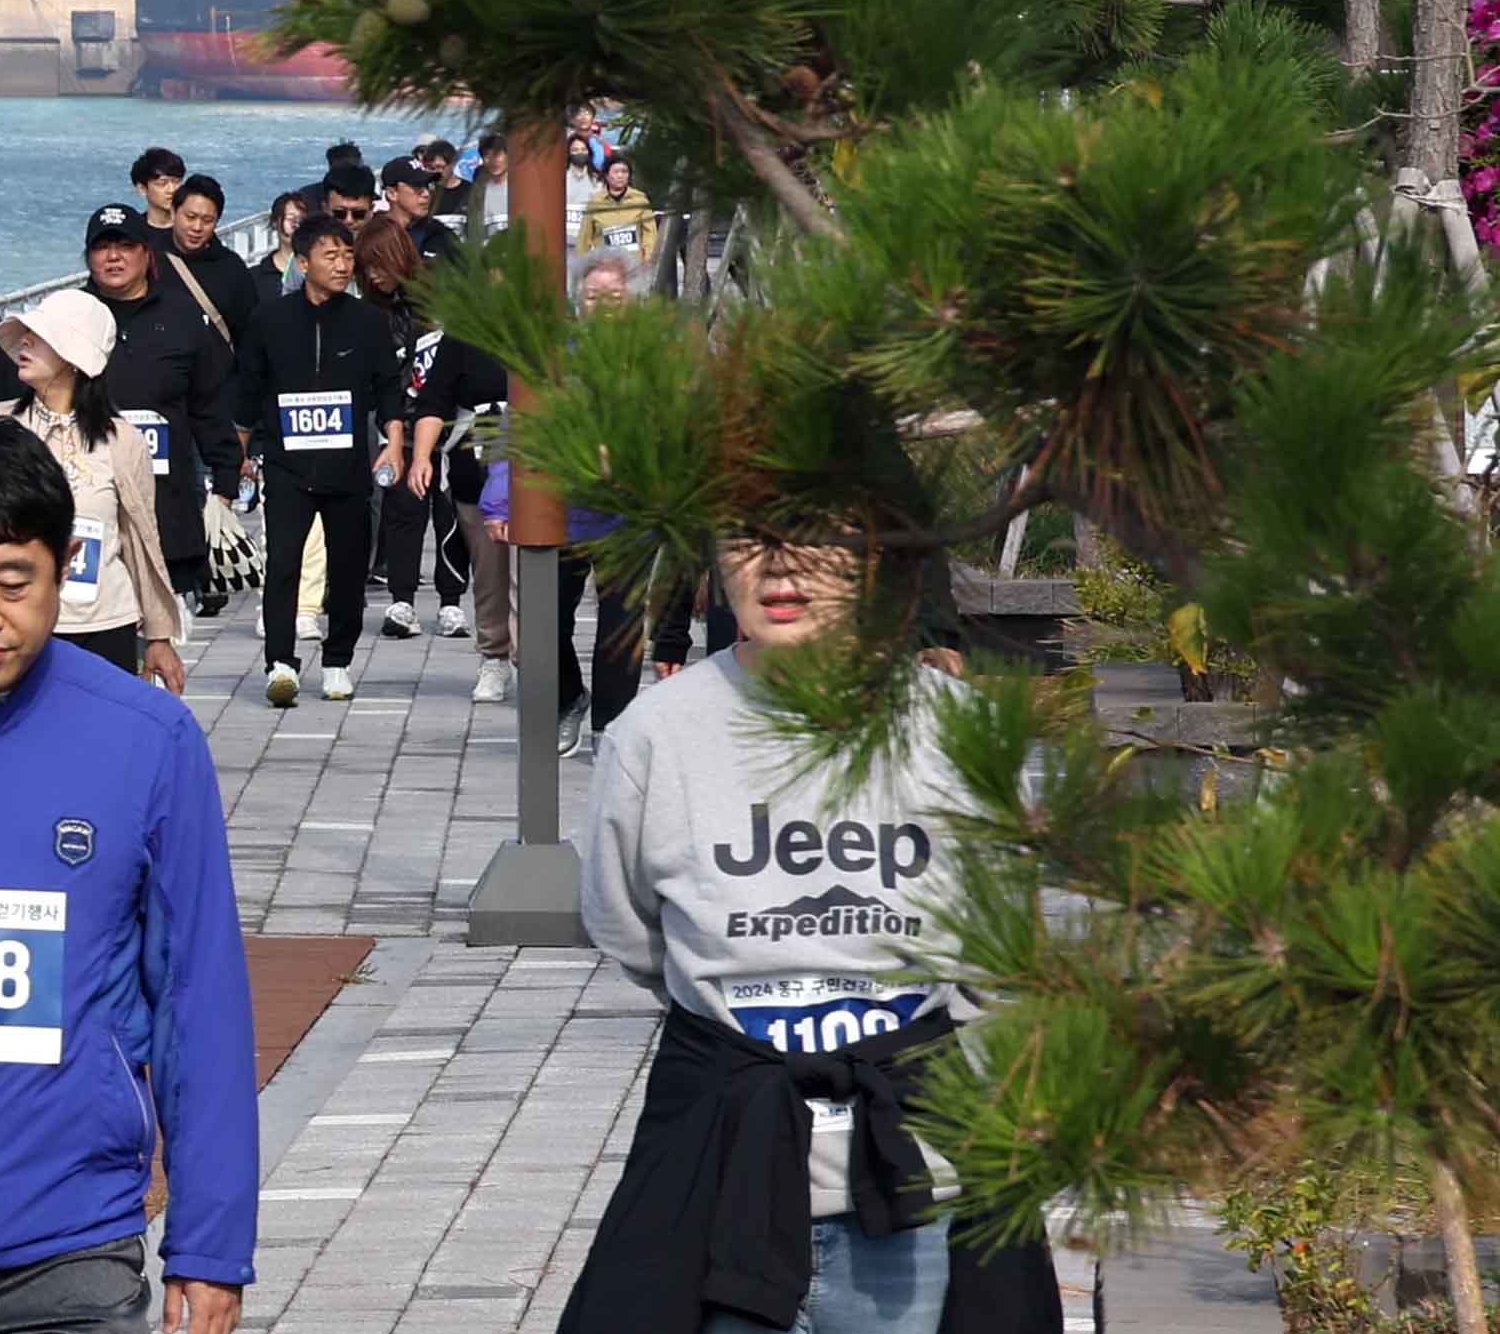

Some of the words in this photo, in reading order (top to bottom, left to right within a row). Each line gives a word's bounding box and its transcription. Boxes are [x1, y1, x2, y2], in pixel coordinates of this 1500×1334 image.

[288, 407, 343, 433] 1604
[713, 803, 932, 889] Jeep
[726, 905, 922, 942] Expedition
[733, 983, 773, 999] 2024
[777, 980, 804, 998] 동구
